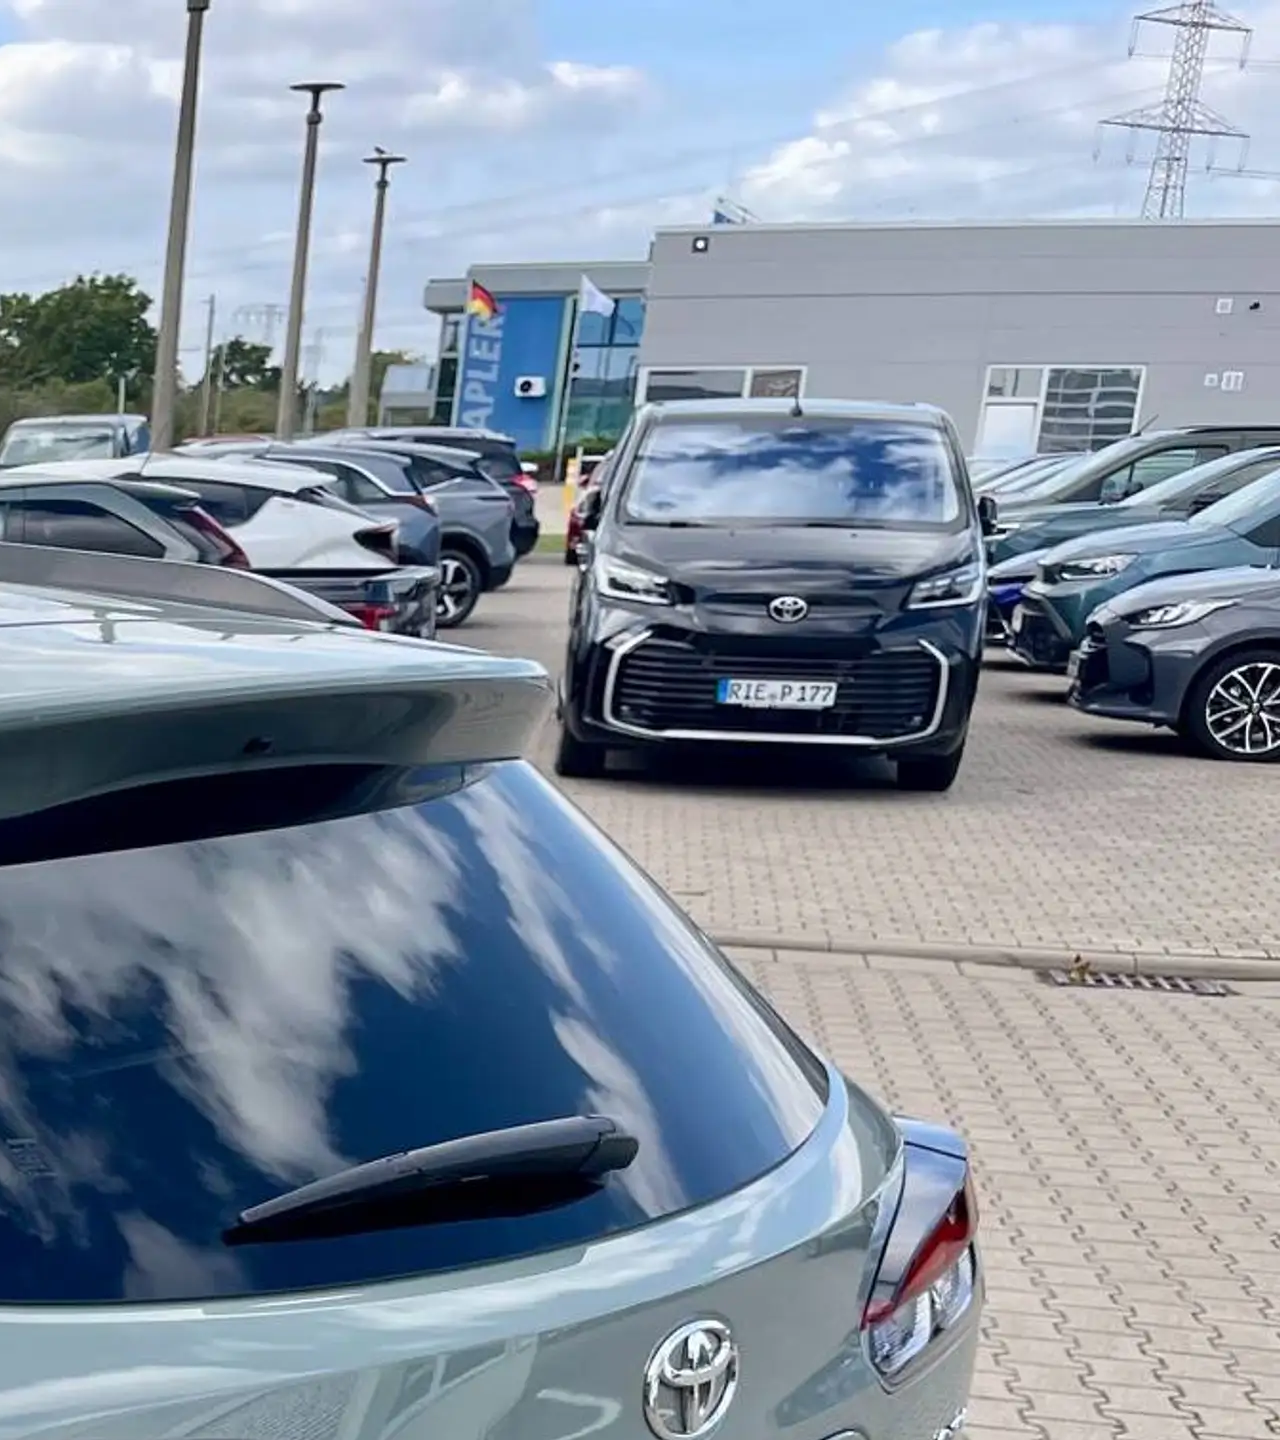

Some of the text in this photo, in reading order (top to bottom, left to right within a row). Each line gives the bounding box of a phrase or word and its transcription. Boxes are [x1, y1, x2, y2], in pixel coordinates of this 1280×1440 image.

[729, 682, 834, 703] RIE P 177
